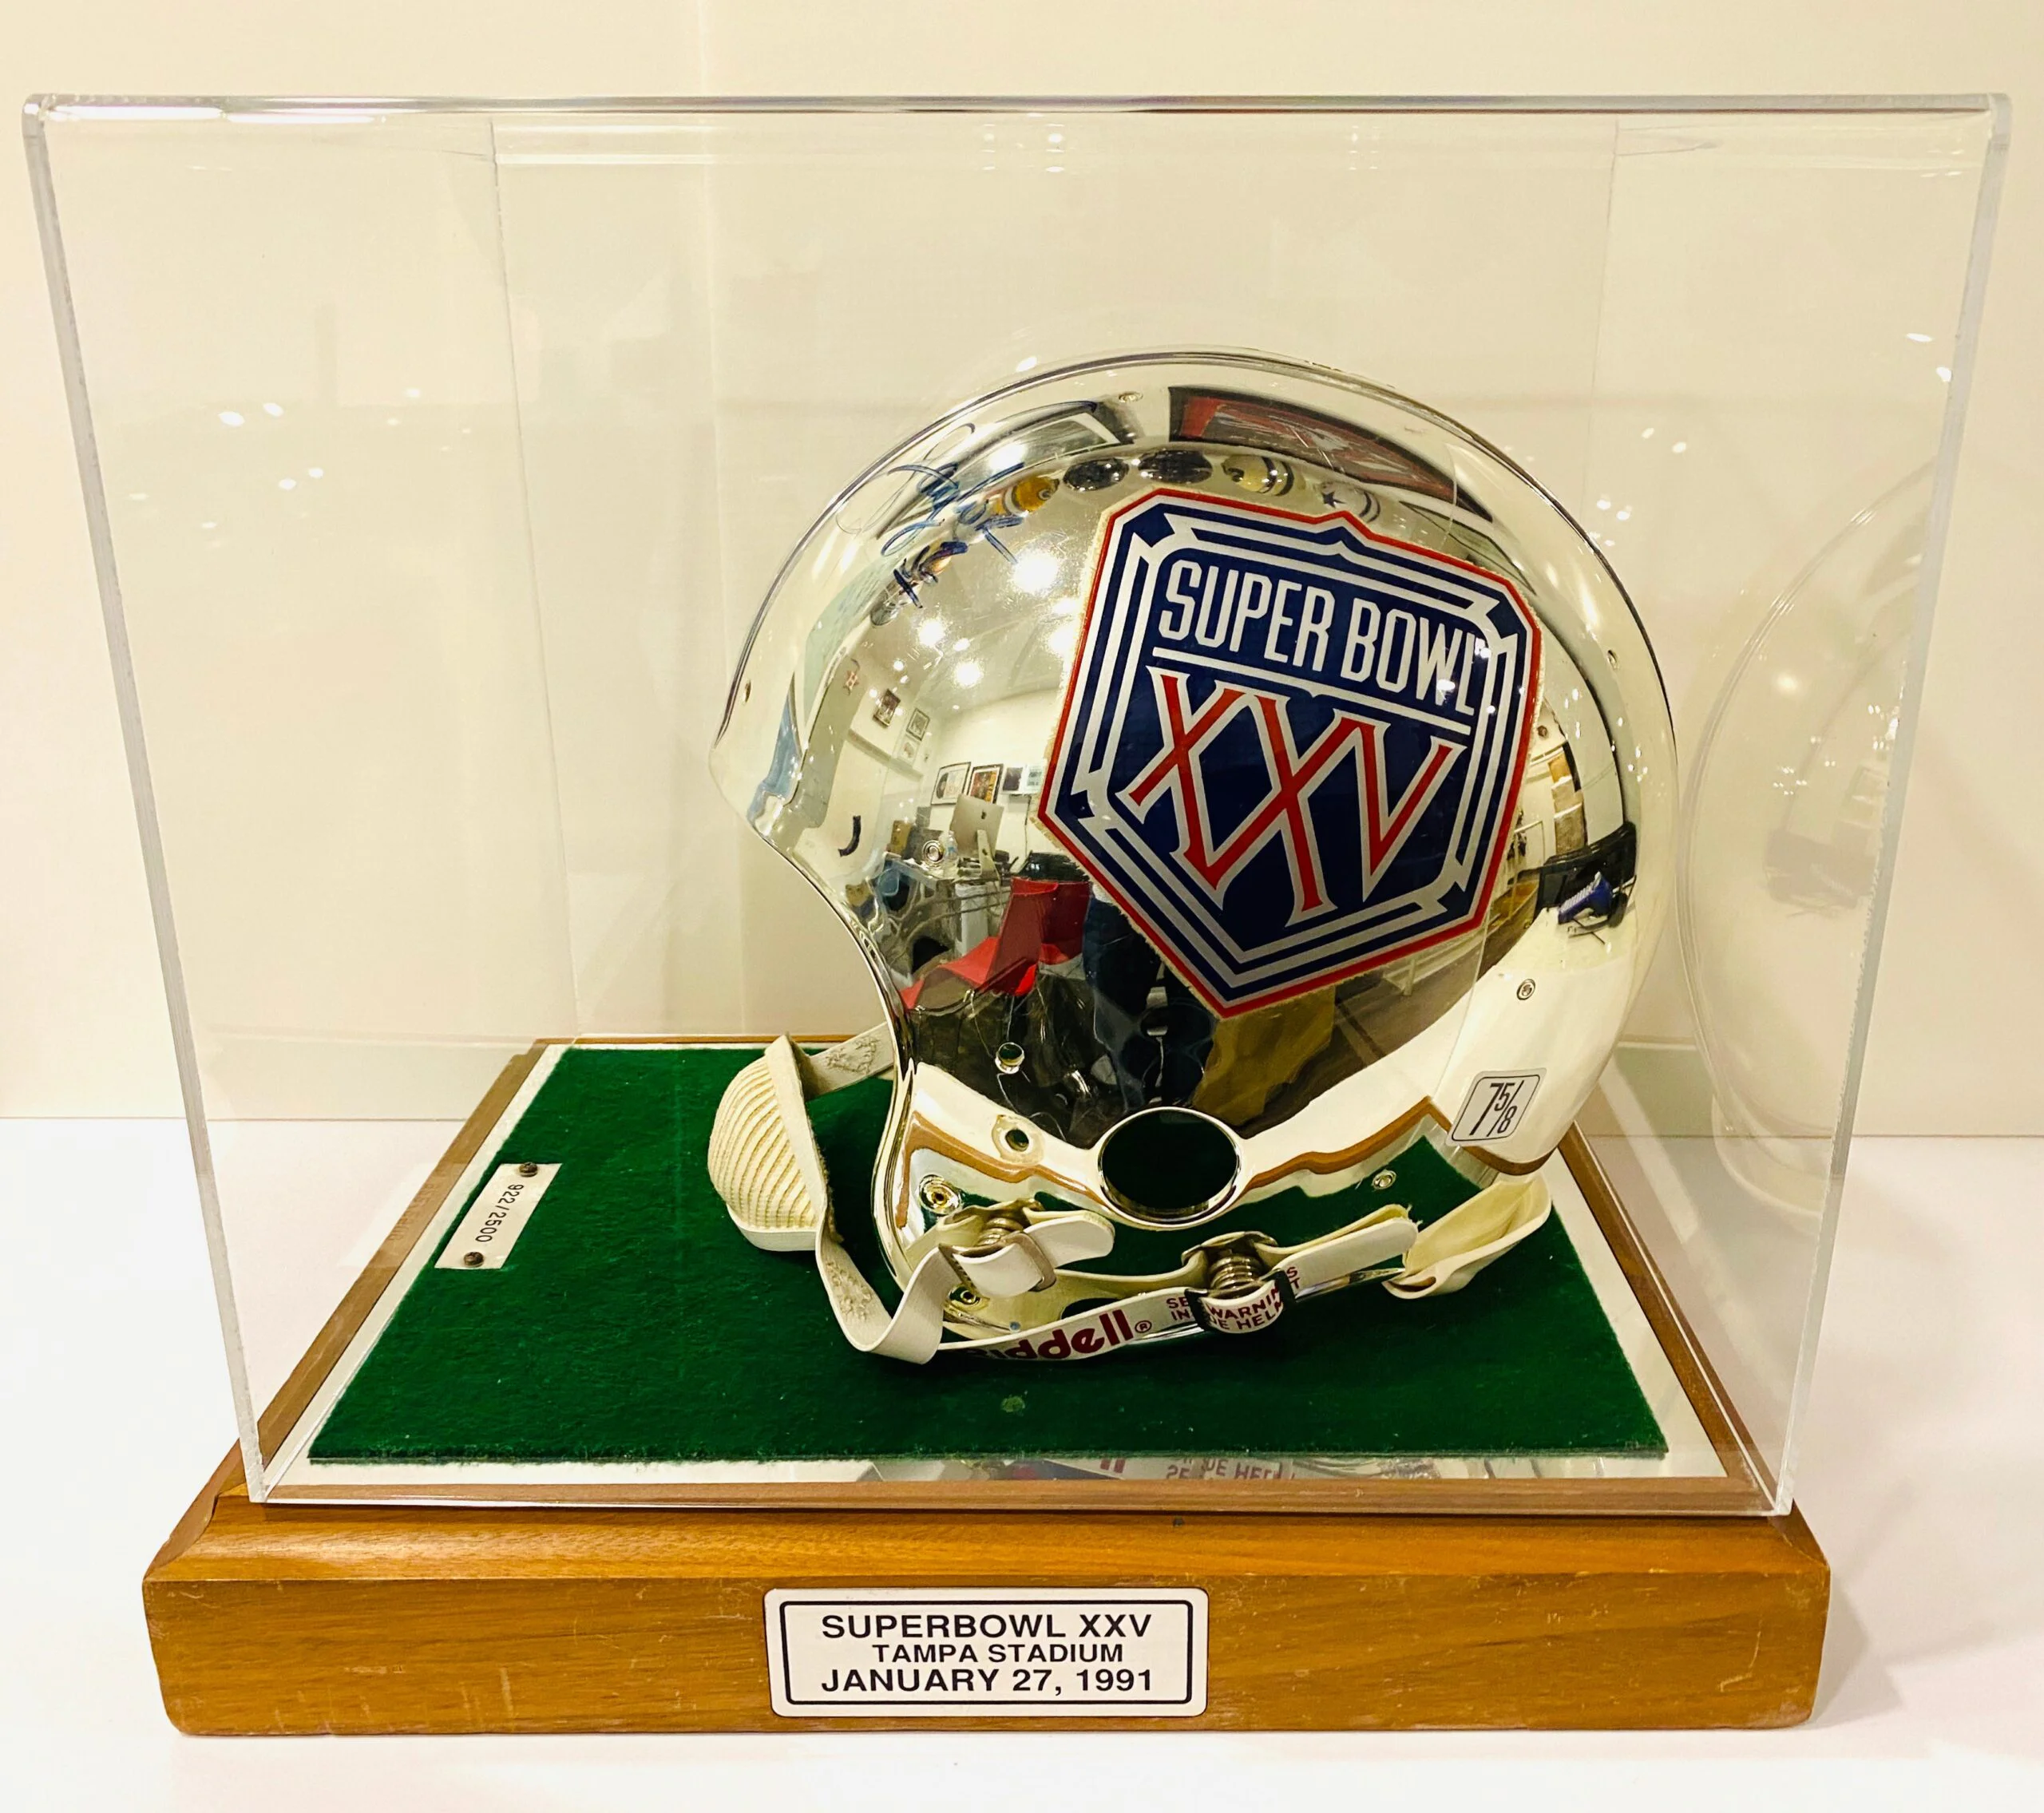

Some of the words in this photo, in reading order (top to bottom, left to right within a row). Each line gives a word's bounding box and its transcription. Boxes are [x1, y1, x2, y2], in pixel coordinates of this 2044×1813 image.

[1159, 560, 1335, 671] SUPER
[1340, 600, 1476, 716] BOWL
[1115, 666, 1468, 926] XXV
[476, 1184, 525, 1242] 922/2500
[1167, 1297, 1189, 1309] SE
[822, 1613, 1066, 1639] SUPERBOWL
[1079, 1613, 1152, 1637] XXV
[873, 1644, 979, 1663] TAMPA
[988, 1644, 1123, 1663] STADIUM
[822, 1669, 999, 1692] JANUARY
[1012, 1669, 1062, 1696] 27,
[1075, 1669, 1152, 1692] 1991
